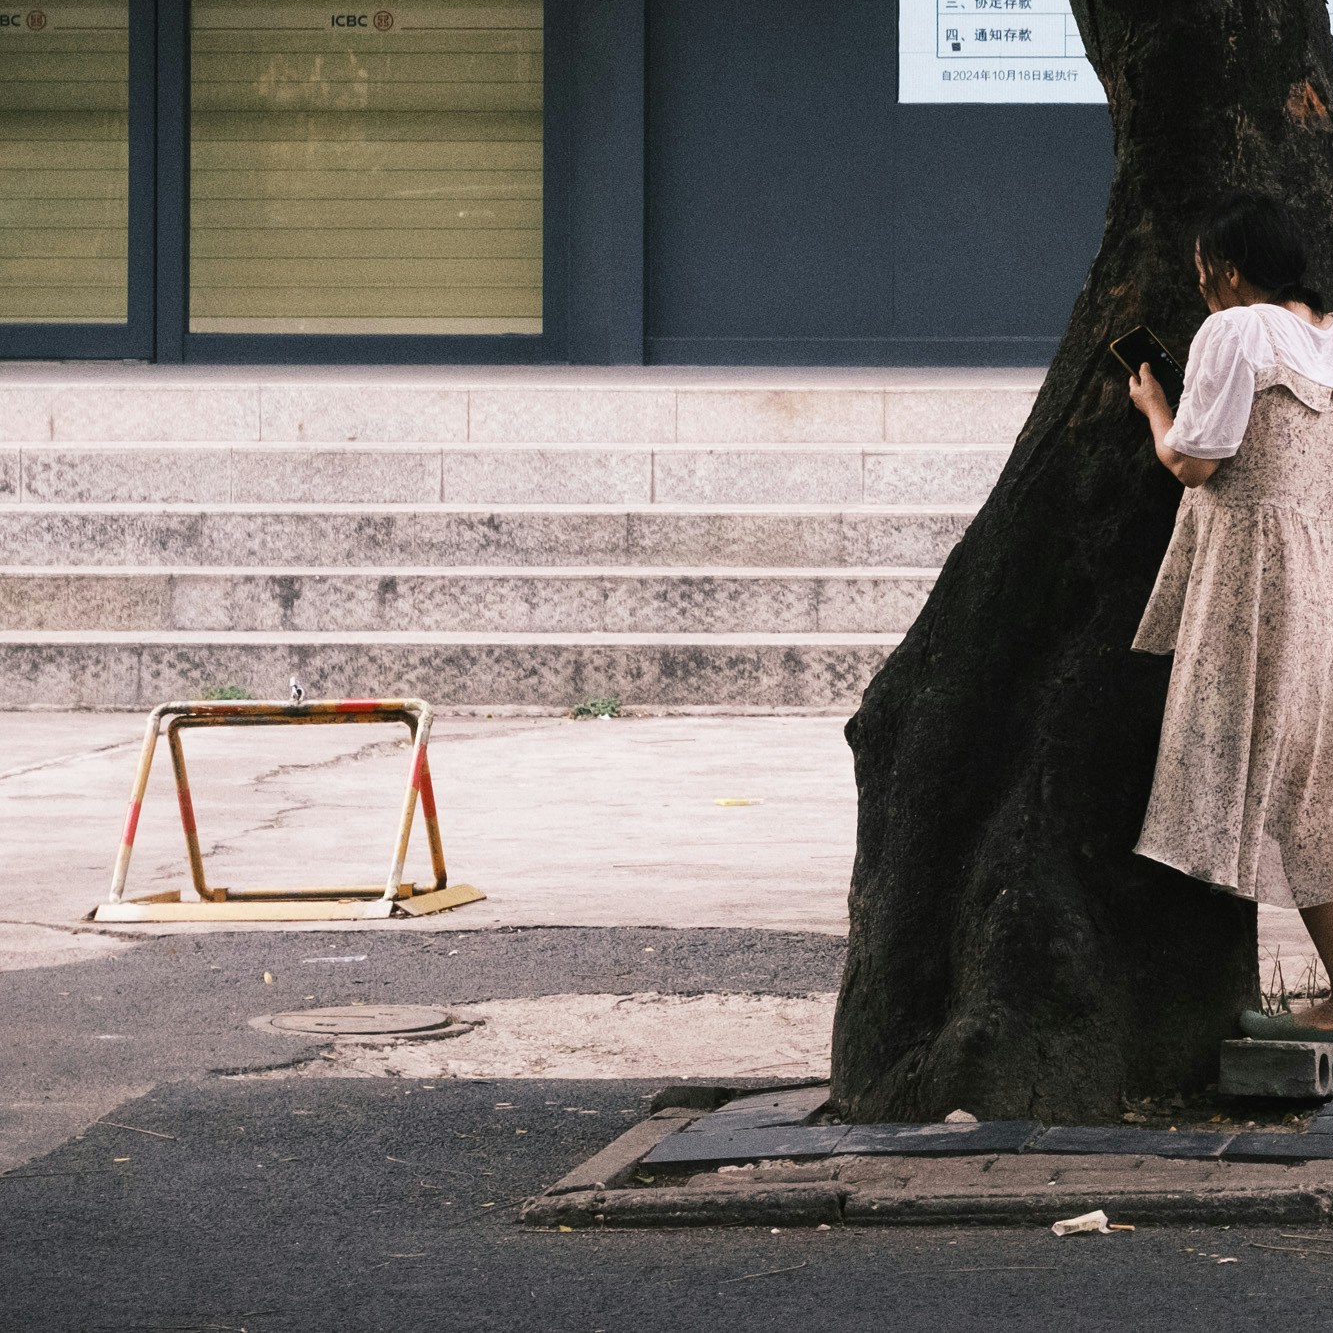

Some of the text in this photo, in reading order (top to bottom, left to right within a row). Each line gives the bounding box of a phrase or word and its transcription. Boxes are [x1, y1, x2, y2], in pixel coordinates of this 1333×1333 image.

[331, 14, 368, 28] ICBC
[945, 29, 1032, 42] 四、通知存款
[942, 70, 1079, 82] 自2024年10月18日起执行
